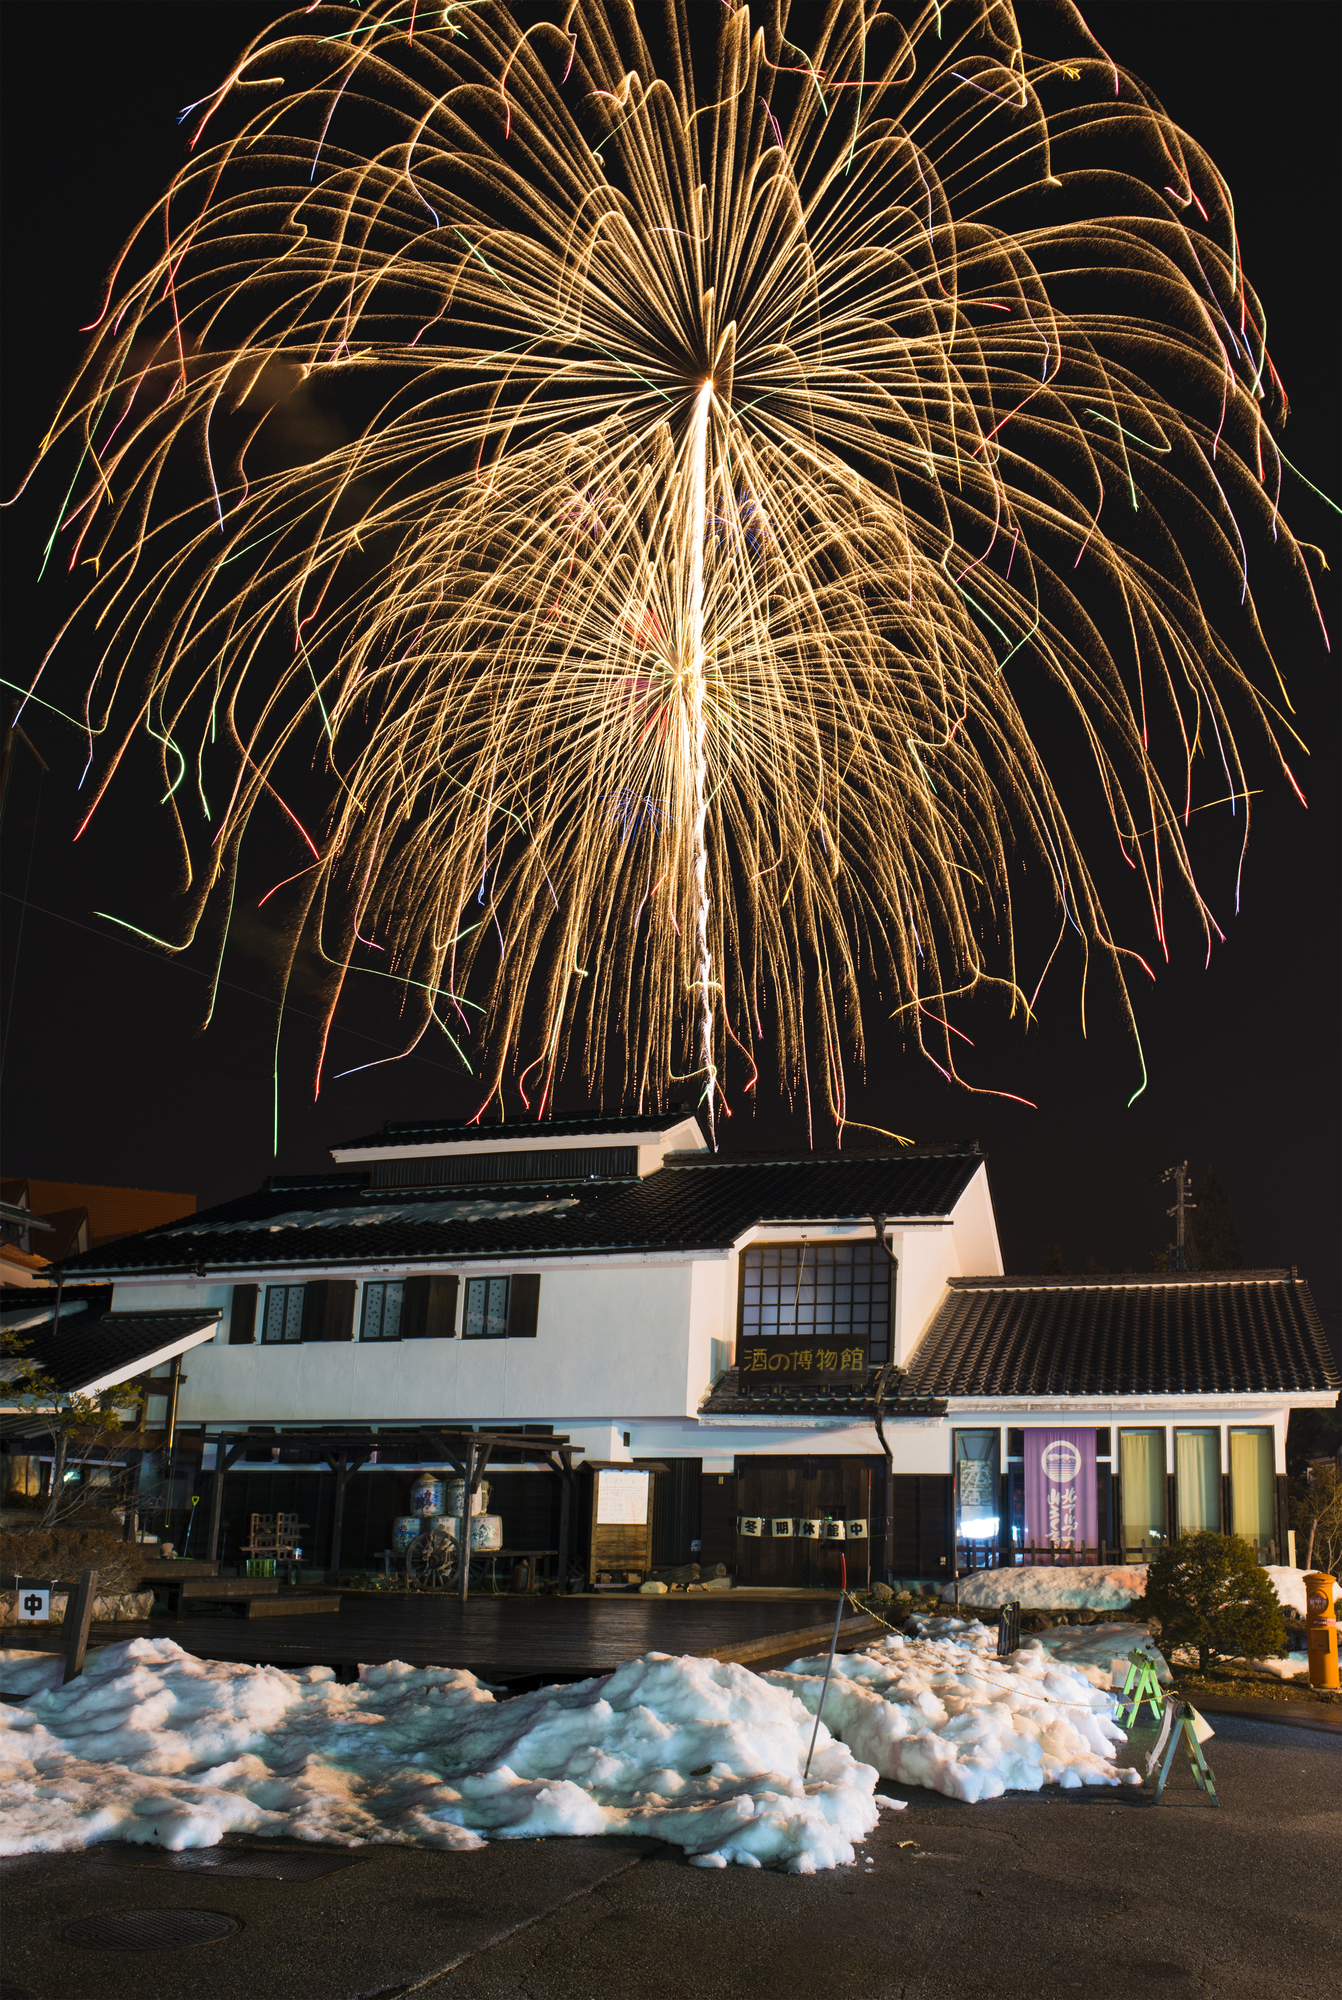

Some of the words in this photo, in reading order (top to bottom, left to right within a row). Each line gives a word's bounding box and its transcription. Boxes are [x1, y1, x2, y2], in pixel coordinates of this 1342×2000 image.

[743, 1347, 864, 1372] 酒の博物館
[744, 1520, 863, 1537] 冬期休館中
[1061, 1487, 1078, 1549] 北アルプス
[24, 1593, 43, 1616] 中
